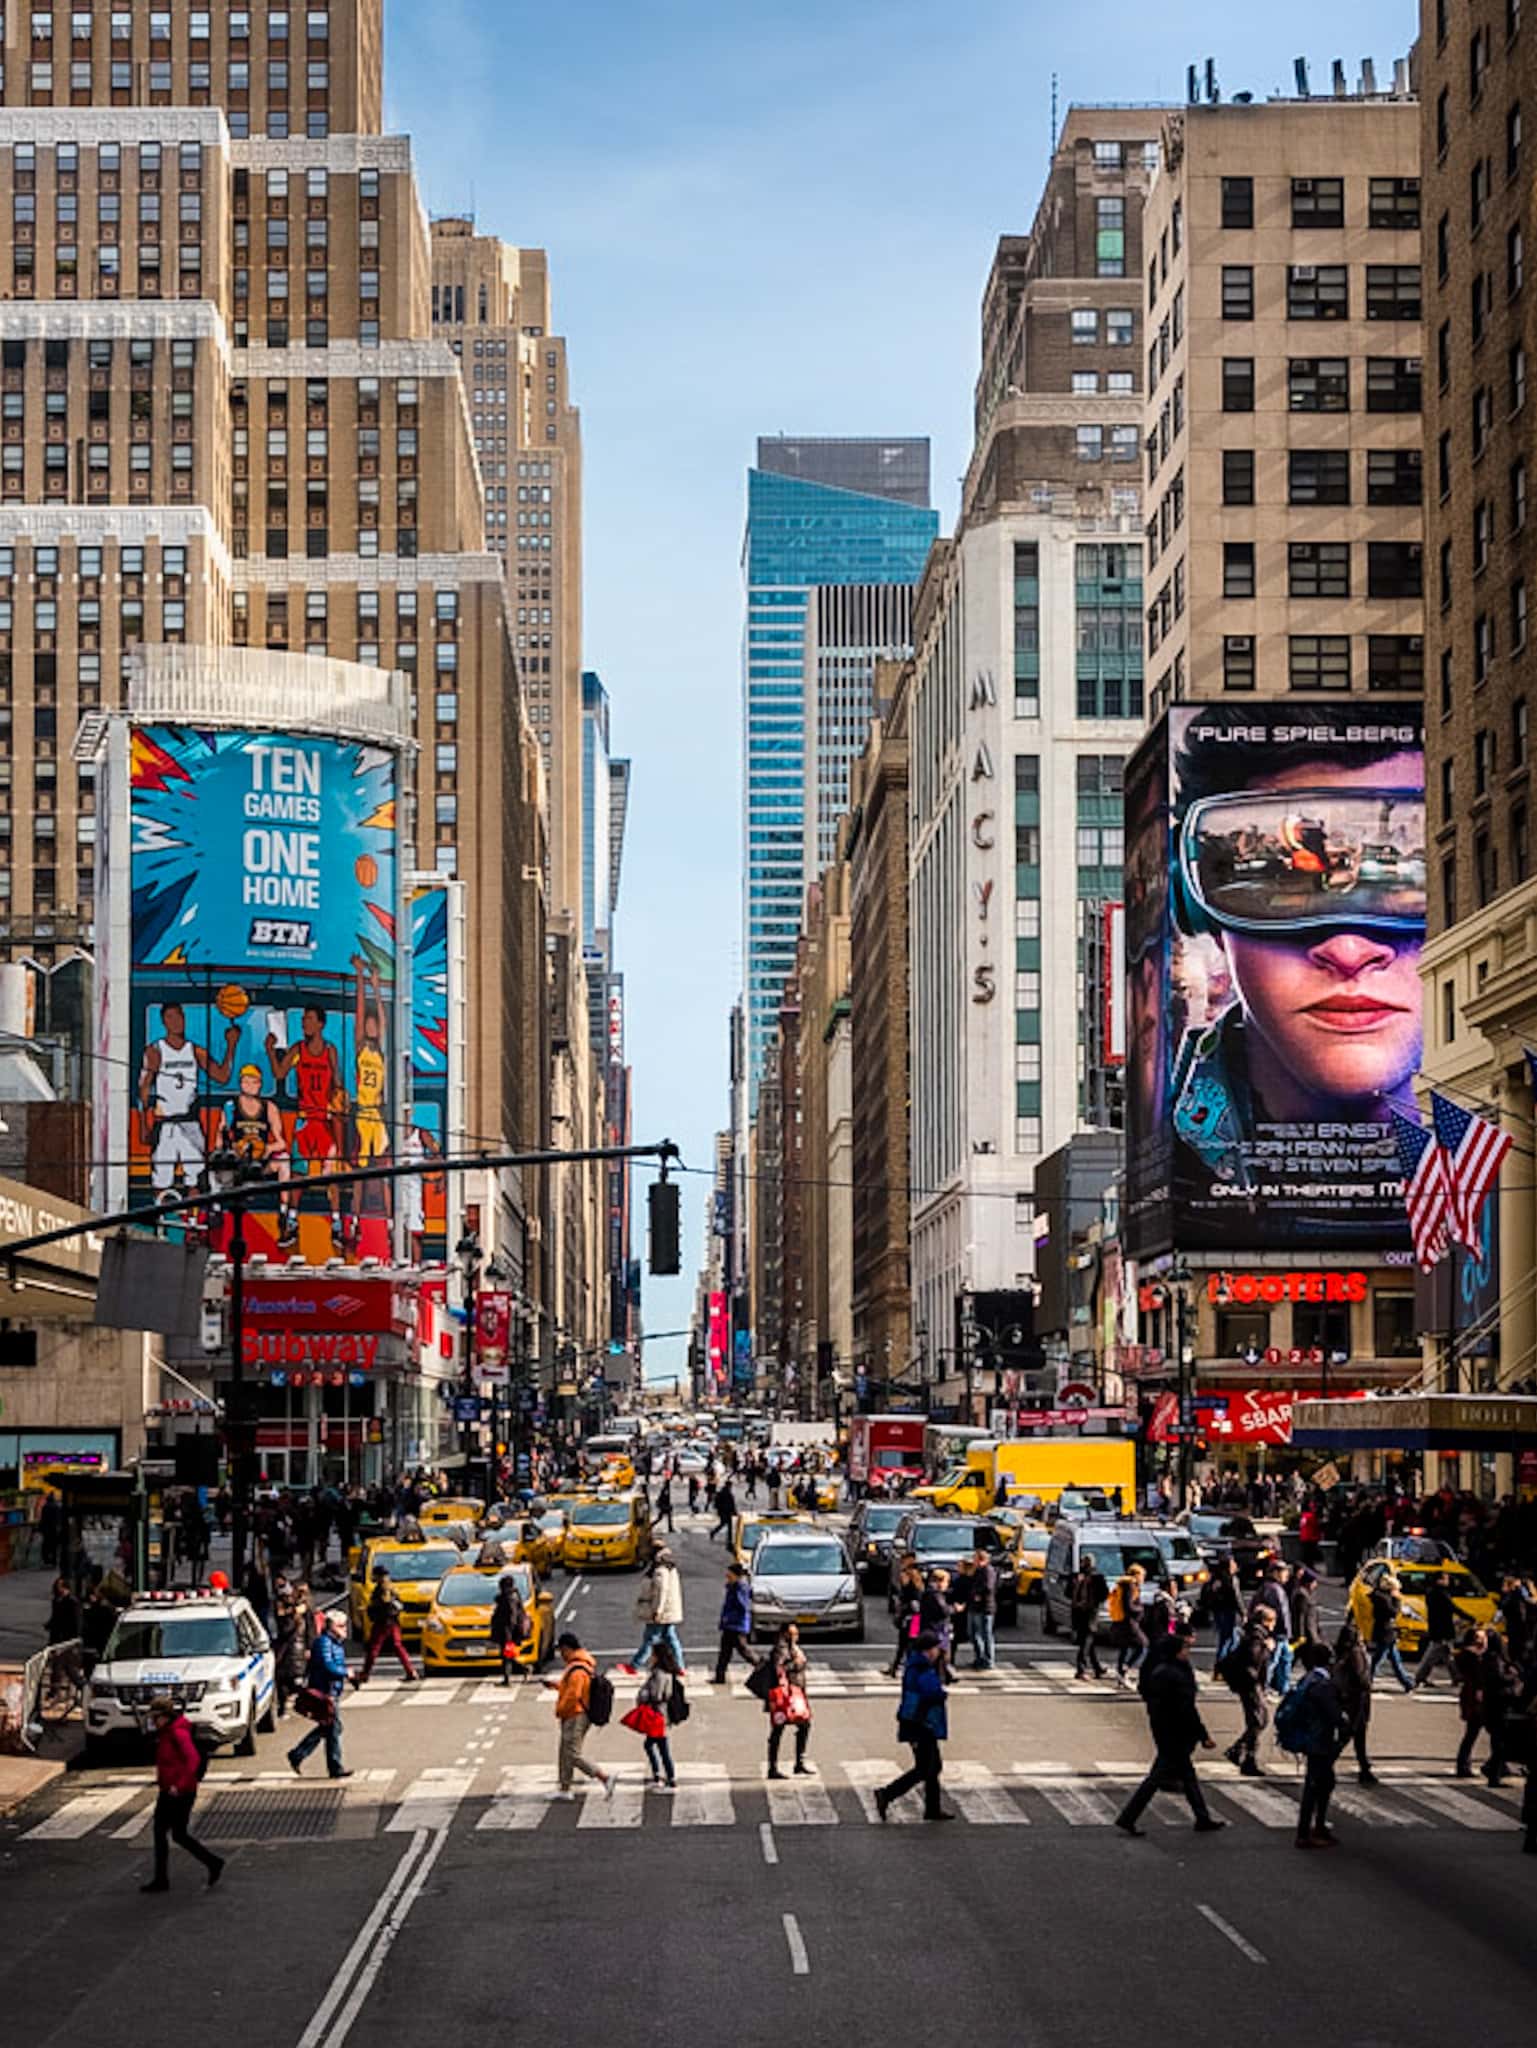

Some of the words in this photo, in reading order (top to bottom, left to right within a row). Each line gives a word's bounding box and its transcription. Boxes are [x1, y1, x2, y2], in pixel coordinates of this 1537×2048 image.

[1271, 725, 1414, 742] SPIELBERG
[244, 745, 321, 796] TEN
[244, 792, 321, 822] GAMES
[243, 829, 320, 878] ONE
[242, 875, 320, 910] HOME
[363, 1069, 378, 1089] 23
[1317, 1122, 1391, 1138] ERNEST
[1285, 1157, 1359, 1173] STEVEN
[1261, 1184, 1280, 1196] IN
[1207, 1272, 1368, 1303] HOOTERS
[242, 1327, 379, 1370] Subway
